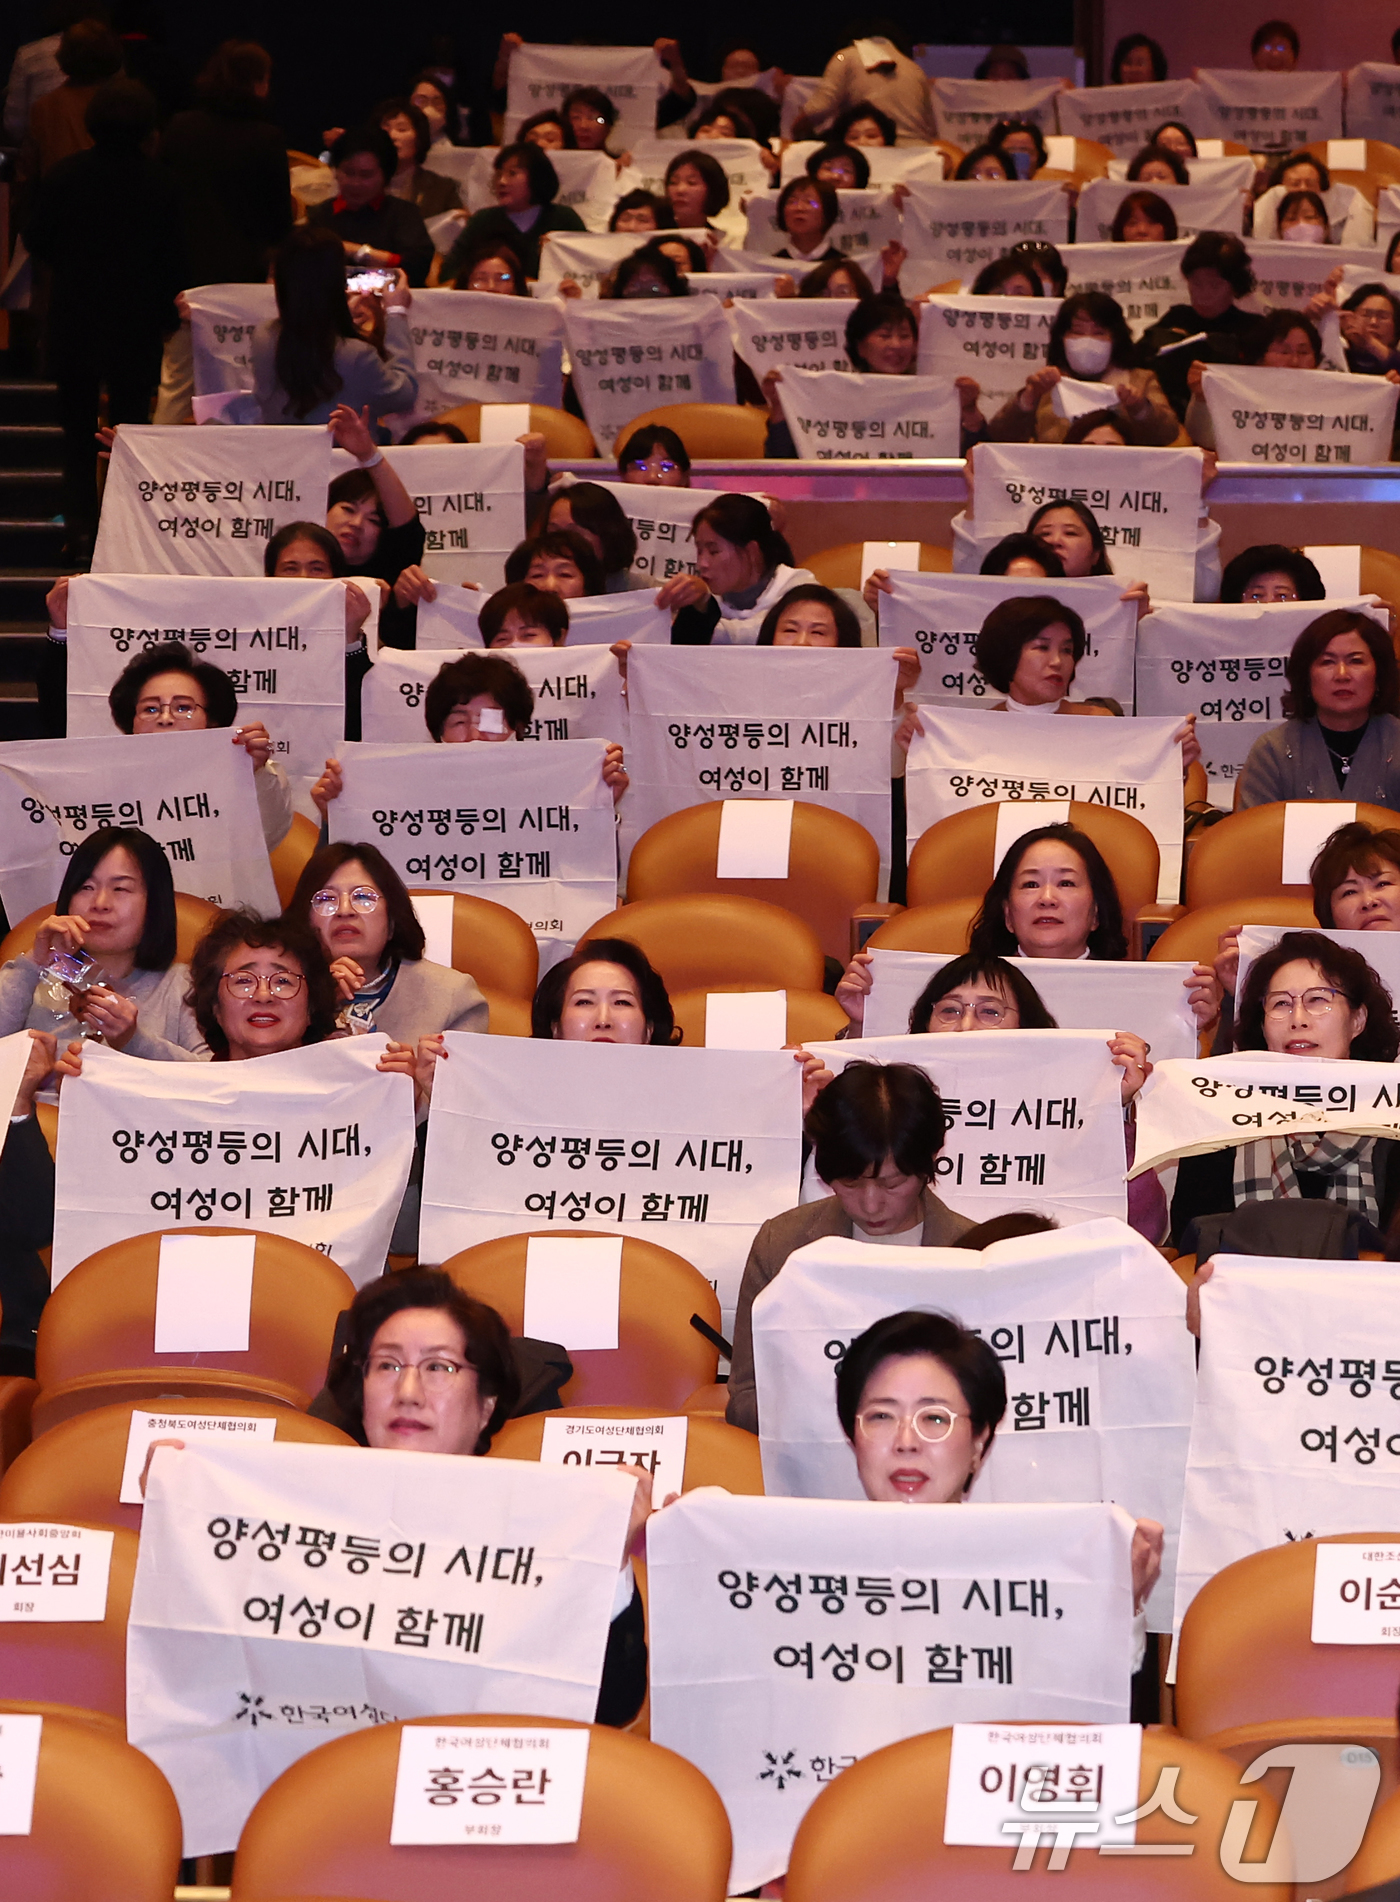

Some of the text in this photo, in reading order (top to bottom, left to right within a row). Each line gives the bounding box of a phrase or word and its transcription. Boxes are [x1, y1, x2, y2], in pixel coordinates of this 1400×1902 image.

[943, 309, 1031, 331] 양성평등의
[411, 327, 497, 351] 양성평등의
[752, 330, 838, 353] 양성평등의
[963, 341, 1015, 360] 여성이
[575, 344, 663, 367] 양성평등의
[427, 359, 521, 384] 여성이 함께
[598, 373, 692, 394] 여성이 함께
[797, 416, 885, 439] 양성평등의
[1232, 409, 1324, 431] 양성평등의
[1251, 443, 1351, 463] 여성이 함께
[138, 479, 301, 503] 양성평등의 시대,
[442, 492, 492, 514] 시대,
[1120, 490, 1169, 514] 시대,
[158, 517, 275, 540] 여성이 함께
[425, 528, 468, 550] 함께
[1100, 526, 1142, 548] 함께
[249, 626, 307, 653] 시대,
[227, 668, 277, 694] 함께
[1171, 656, 1288, 684] 양성평등의
[539, 674, 597, 700] 시대,
[942, 672, 989, 697] 여성
[1200, 696, 1270, 722] 여성이
[668, 721, 858, 750] 양성평등의 시대,
[699, 765, 829, 792] 여성이 함께
[157, 792, 220, 822] 시대,
[1088, 785, 1146, 810] 시대,
[372, 805, 579, 837] 양성평등의 시대,
[406, 850, 550, 881] 여성이 함께
[1010, 1097, 1084, 1130] 시대,
[112, 1123, 372, 1165] 양성평등의 시대,
[491, 1132, 753, 1174] 양성평등의 시대,
[979, 1152, 1046, 1186] 함께
[150, 1183, 333, 1221] 여성이 함께
[524, 1190, 709, 1223] 여성이 함께
[1044, 1316, 1133, 1358] 시대,
[1011, 1386, 1090, 1432] 함께
[147, 1418, 258, 1433] 충청북도여성단체협의회
[565, 1424, 665, 1436] 경기도여성단체협의회
[207, 1516, 544, 1588] 양성평등의 시대,
[718, 1569, 1065, 1620] 양성평등의 시대,
[243, 1593, 485, 1654] 여성이 함께
[773, 1641, 1013, 1685] 여성이 함께
[424, 1766, 552, 1806] 홍승란
[980, 1763, 1104, 1804] 이영휘
